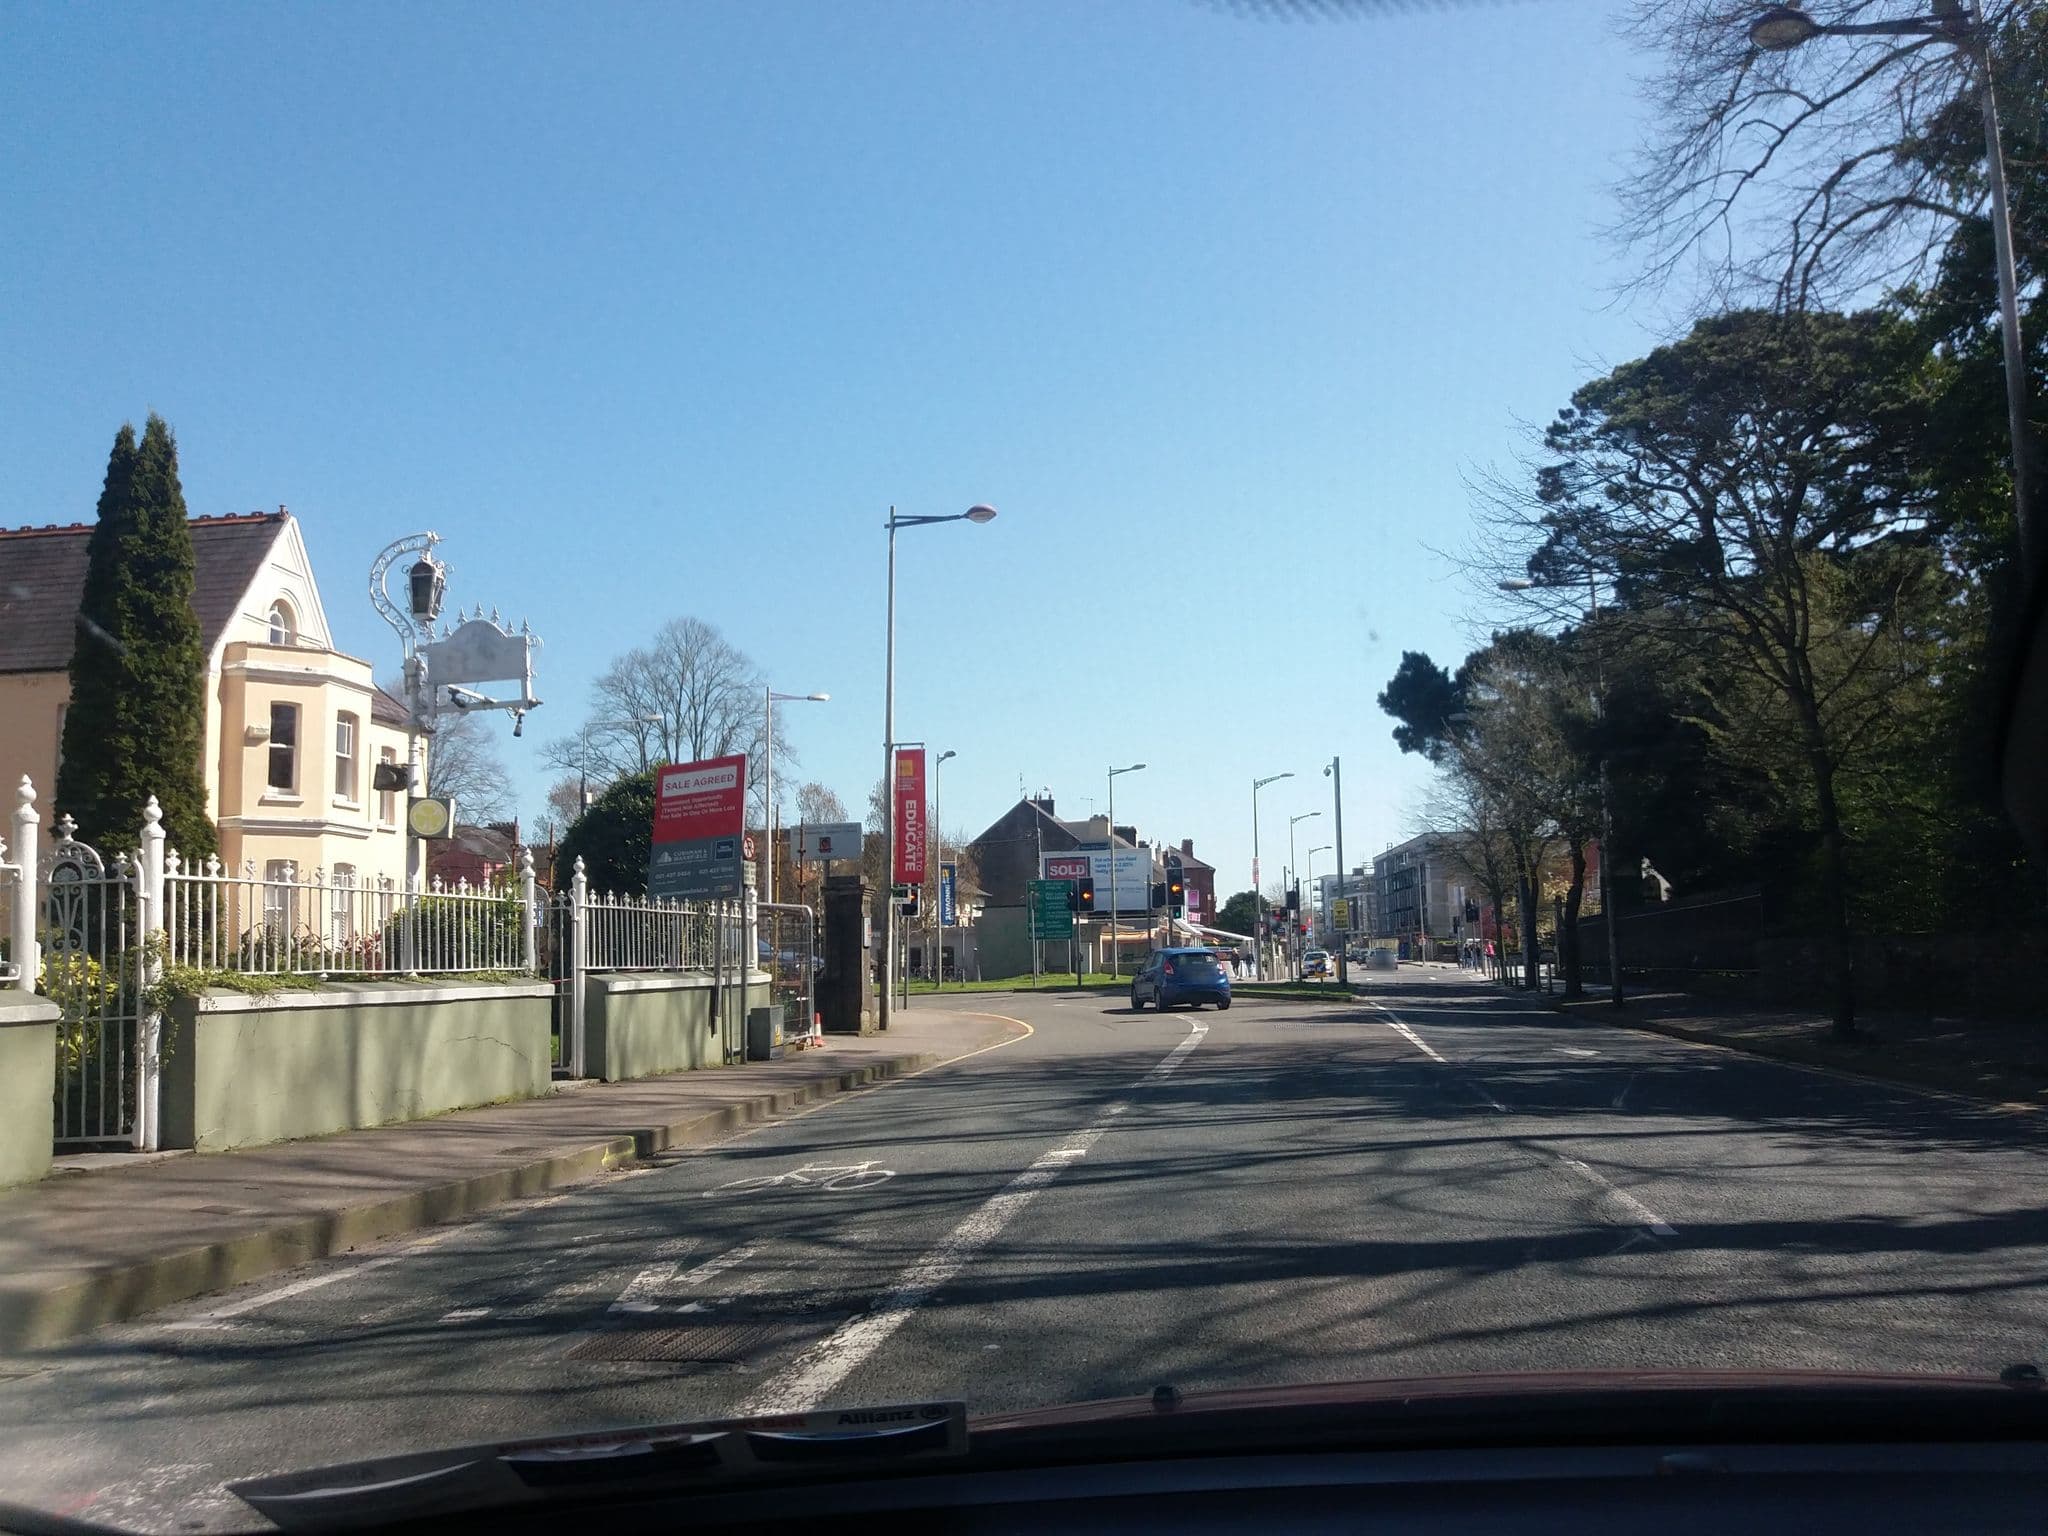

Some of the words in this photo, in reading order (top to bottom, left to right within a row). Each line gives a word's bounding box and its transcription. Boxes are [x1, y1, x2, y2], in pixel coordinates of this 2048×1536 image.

[665, 780, 691, 791] SALE
[691, 773, 735, 787] AGREED
[905, 799, 917, 872] EDUCATE
[917, 860, 923, 872] TO
[1049, 865, 1085, 877] SOLD
[945, 882, 953, 921] INNOVATE
[838, 1410, 915, 1425] Allianz
